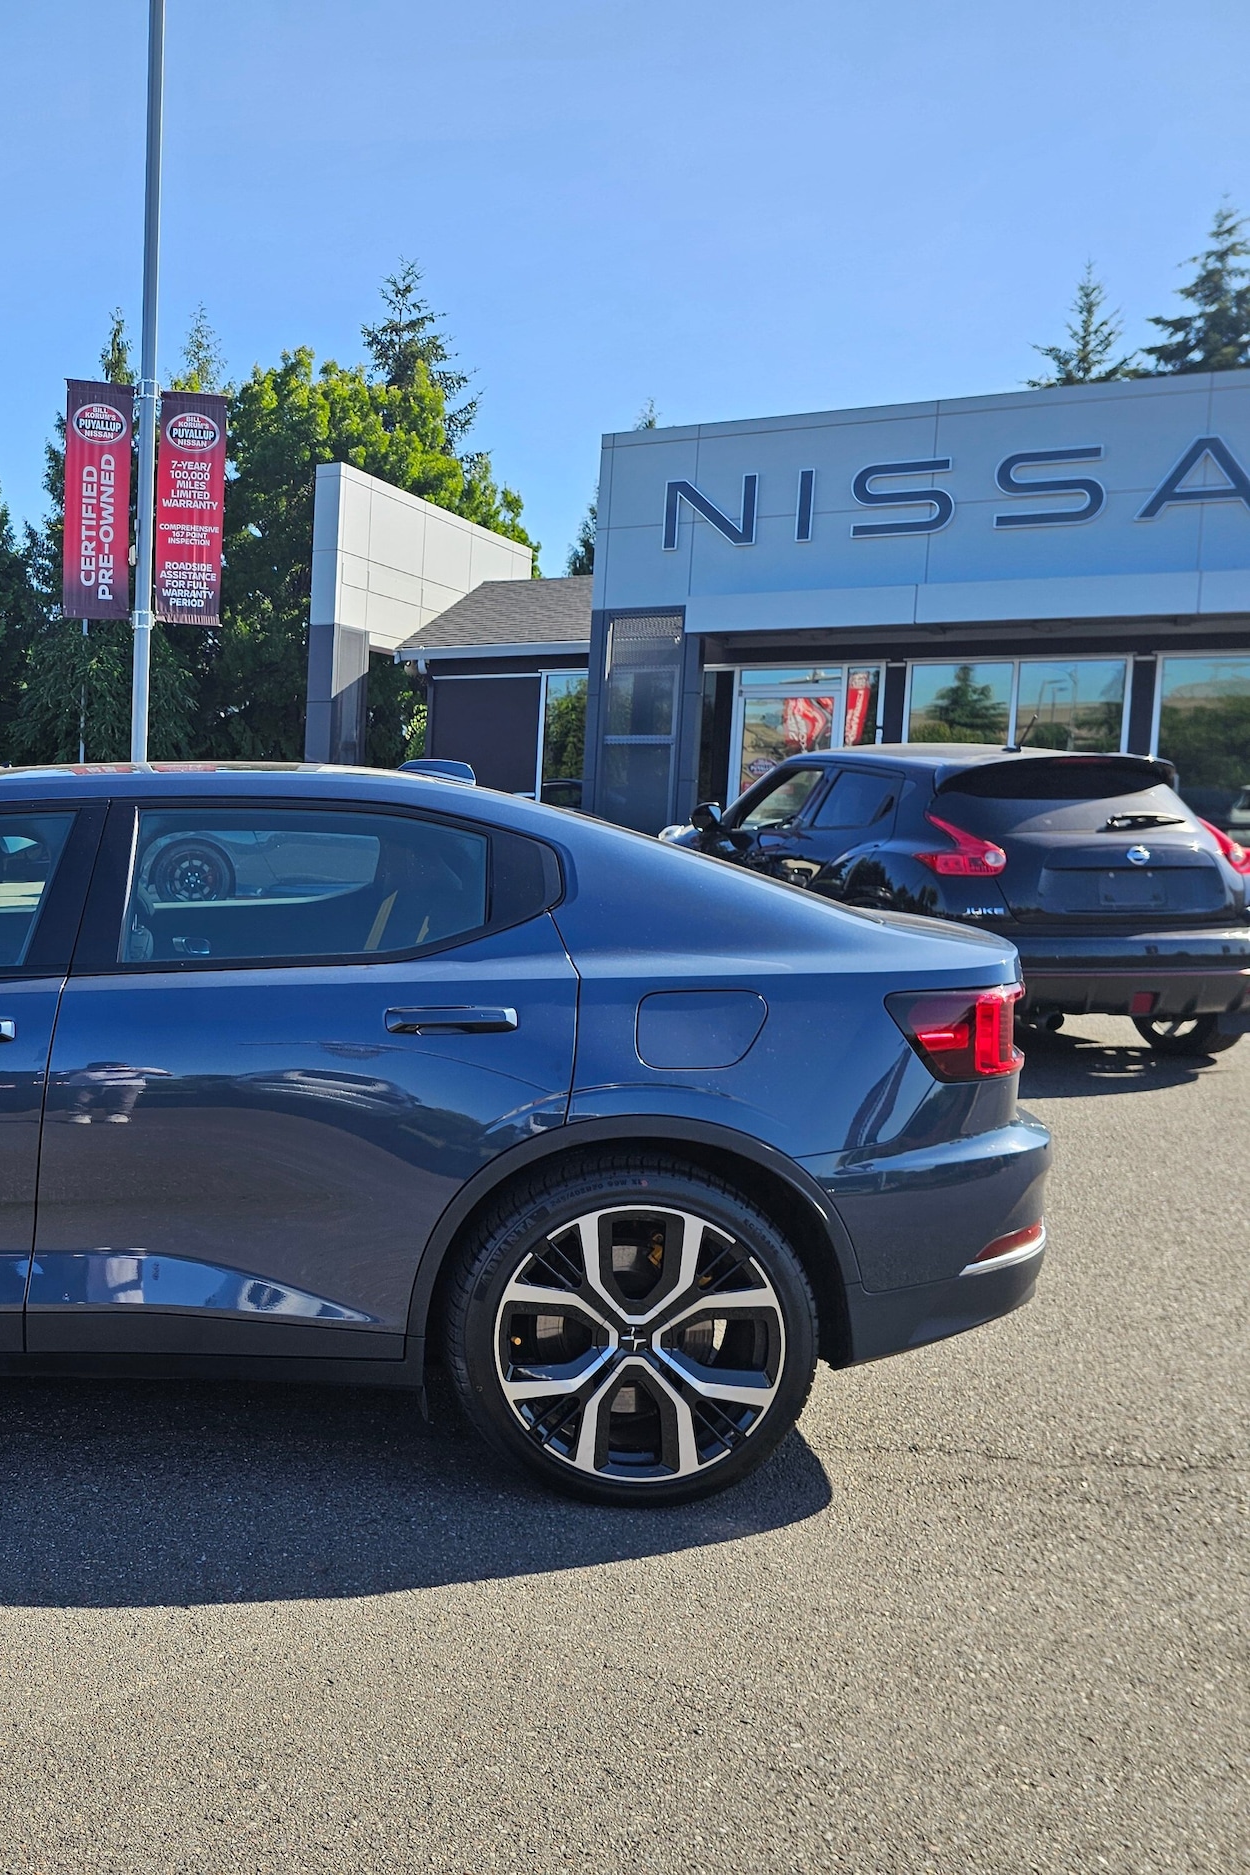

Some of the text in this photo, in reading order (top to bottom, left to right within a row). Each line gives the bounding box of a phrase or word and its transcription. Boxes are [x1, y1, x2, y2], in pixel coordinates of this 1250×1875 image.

[85, 411, 116, 420] KORUM'S
[93, 406, 108, 414] BILL
[79, 419, 122, 433] PUYALLUP
[178, 421, 209, 430] KORUM'S
[84, 429, 114, 439] NISSAN
[172, 428, 215, 441] PUYALLUP
[177, 438, 207, 447] NISSAN
[171, 460, 212, 472] 7-YEAR/
[170, 470, 210, 481] 100,000
[176, 480, 206, 490] MILES
[171, 489, 210, 500] LIMITED
[162, 498, 218, 511] WARRANTY
[80, 465, 98, 586] CERTIFIED
[98, 453, 115, 600] PRE-OWNED
[159, 523, 220, 534] COMPREHENSIVE
[172, 530, 207, 539] 167 POINT
[168, 537, 210, 546] INSPECTION
[165, 561, 212, 572] ROADSIDE
[160, 570, 217, 581] ASSISTANCE
[165, 579, 209, 590] FOR FULL
[162, 588, 214, 599] WARRANTY
[170, 598, 204, 607] PERIOD
[964, 907, 1004, 916] JUKE
[481, 1217, 536, 1285] ADVANTA
